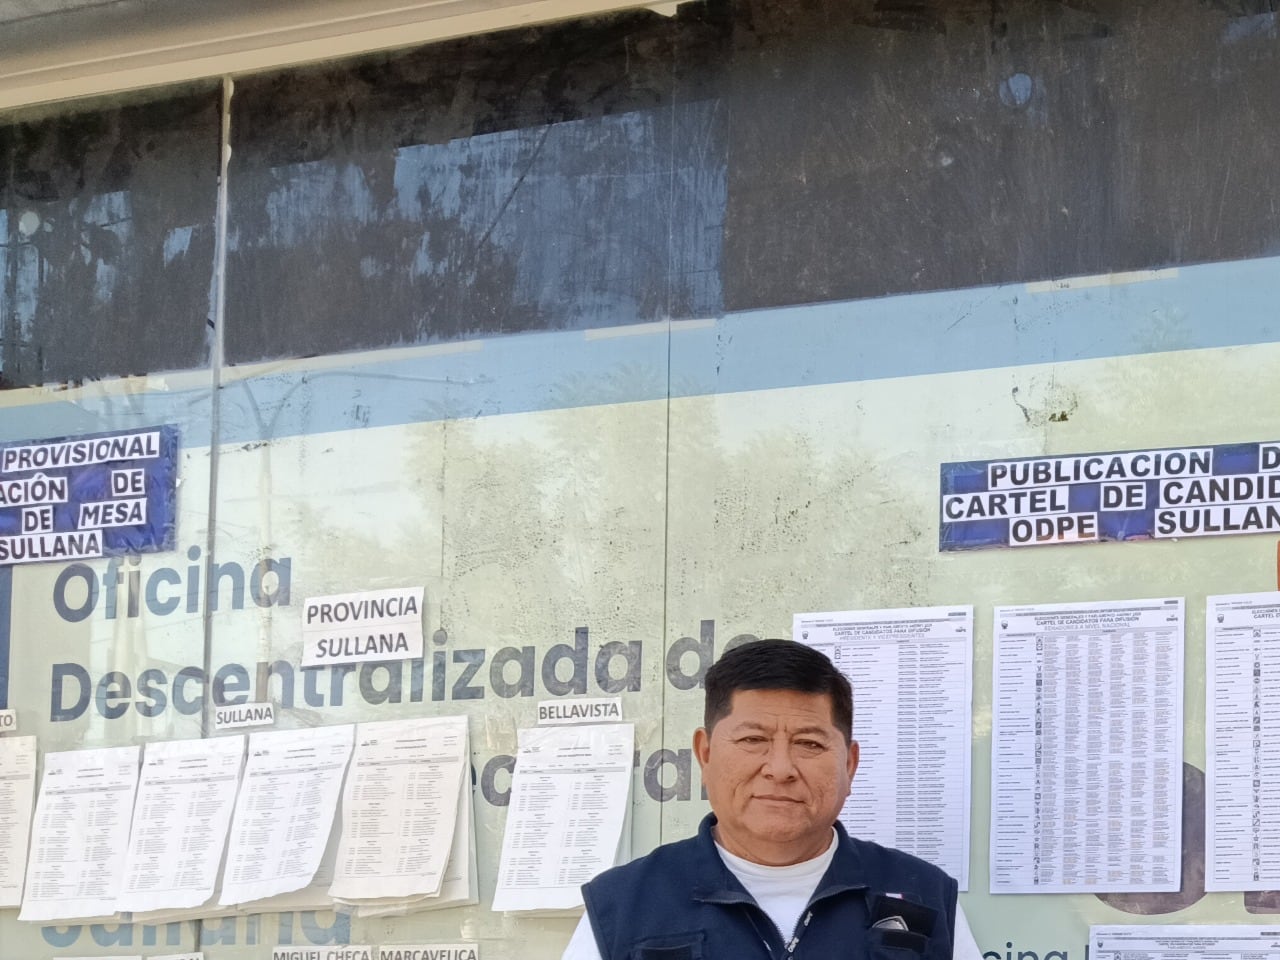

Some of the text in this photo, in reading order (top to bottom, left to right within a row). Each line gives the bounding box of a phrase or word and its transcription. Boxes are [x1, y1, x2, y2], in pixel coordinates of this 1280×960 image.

[4, 434, 157, 470] PROVISIONAL
[114, 471, 142, 493] DE
[990, 451, 1211, 487] PUBLICACION
[25, 502, 142, 531] DE MESA
[945, 490, 1066, 520] CARTEL
[1103, 486, 1143, 508] DE
[1012, 515, 1095, 543] ODPE
[0, 533, 100, 560] SULLANA
[54, 545, 291, 623] Oficina
[307, 596, 418, 624] PROVINCIA
[316, 632, 409, 658] SULLANA
[49, 627, 641, 722] Descentralizada
[217, 707, 272, 725] SULLANA
[539, 703, 619, 720] BELLAVISTA
